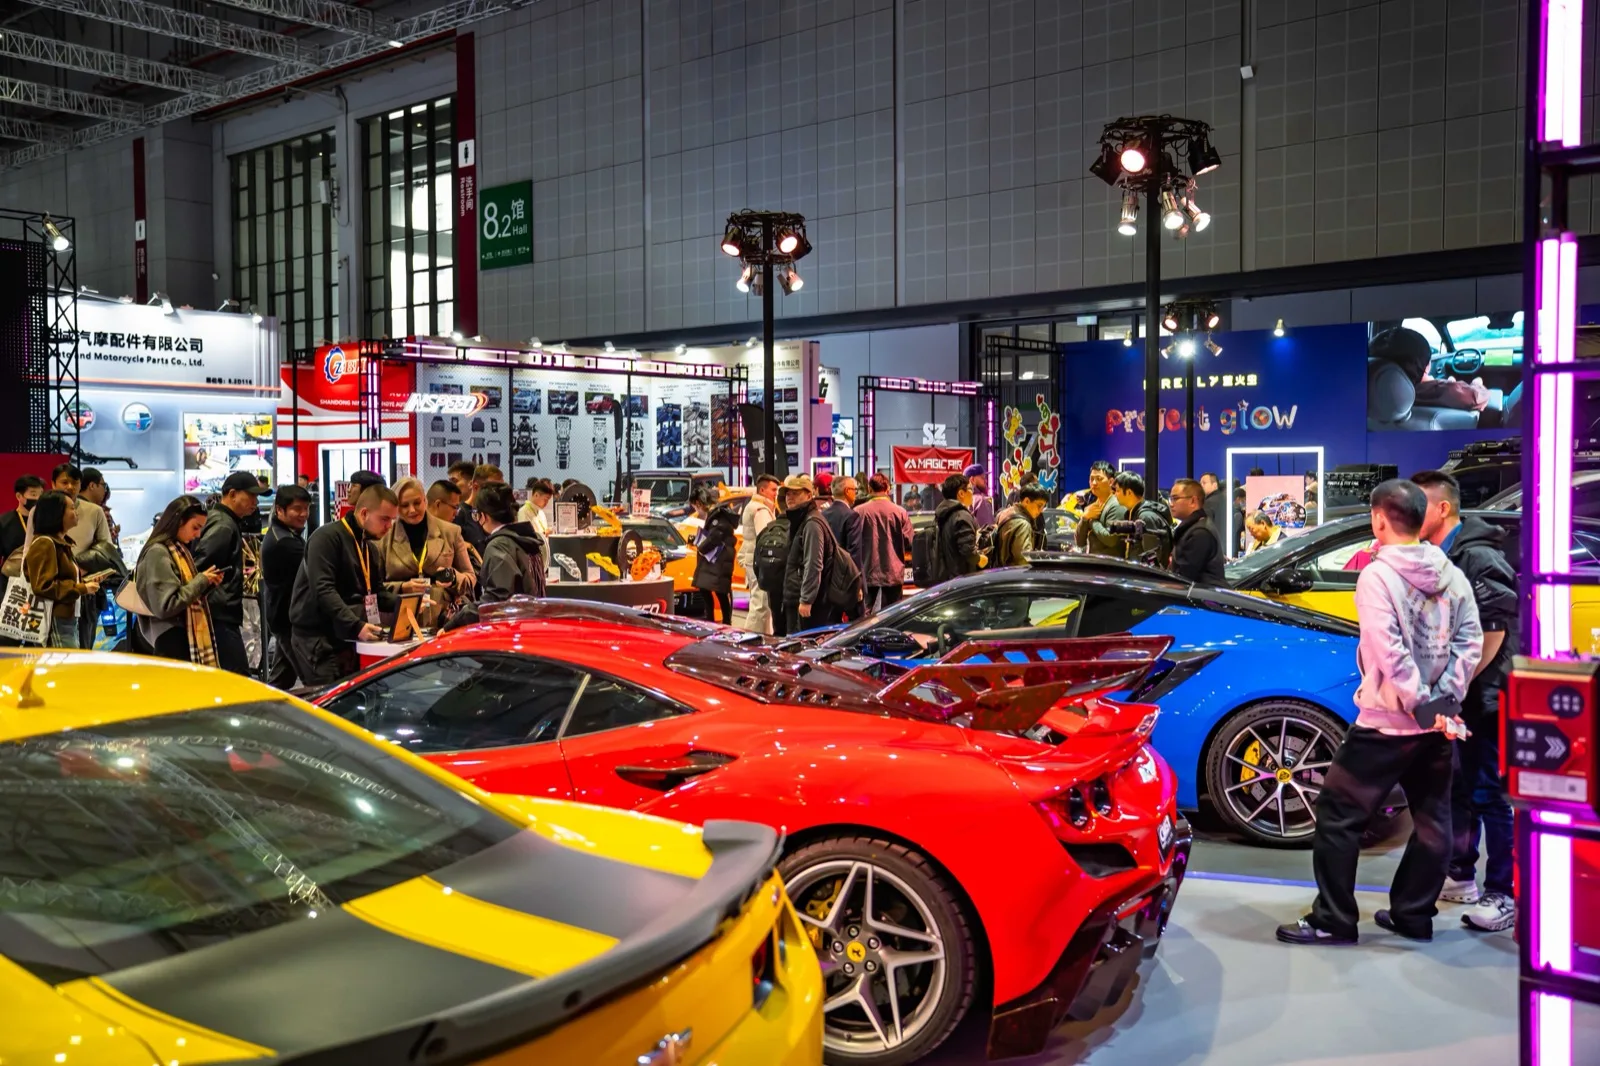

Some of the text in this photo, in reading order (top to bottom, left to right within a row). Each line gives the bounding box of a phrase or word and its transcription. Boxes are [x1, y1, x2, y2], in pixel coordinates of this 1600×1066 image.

[484, 202, 511, 240] 8.2
[512, 224, 528, 236] Hall
[94, 352, 144, 364] Motorcycle
[146, 356, 169, 365] Parts
[171, 357, 187, 367] Co.,
[189, 358, 205, 367] Ltd.
[402, 392, 478, 415] INSPEED
[1220, 399, 1298, 435] glow
[922, 422, 947, 447] SZ
